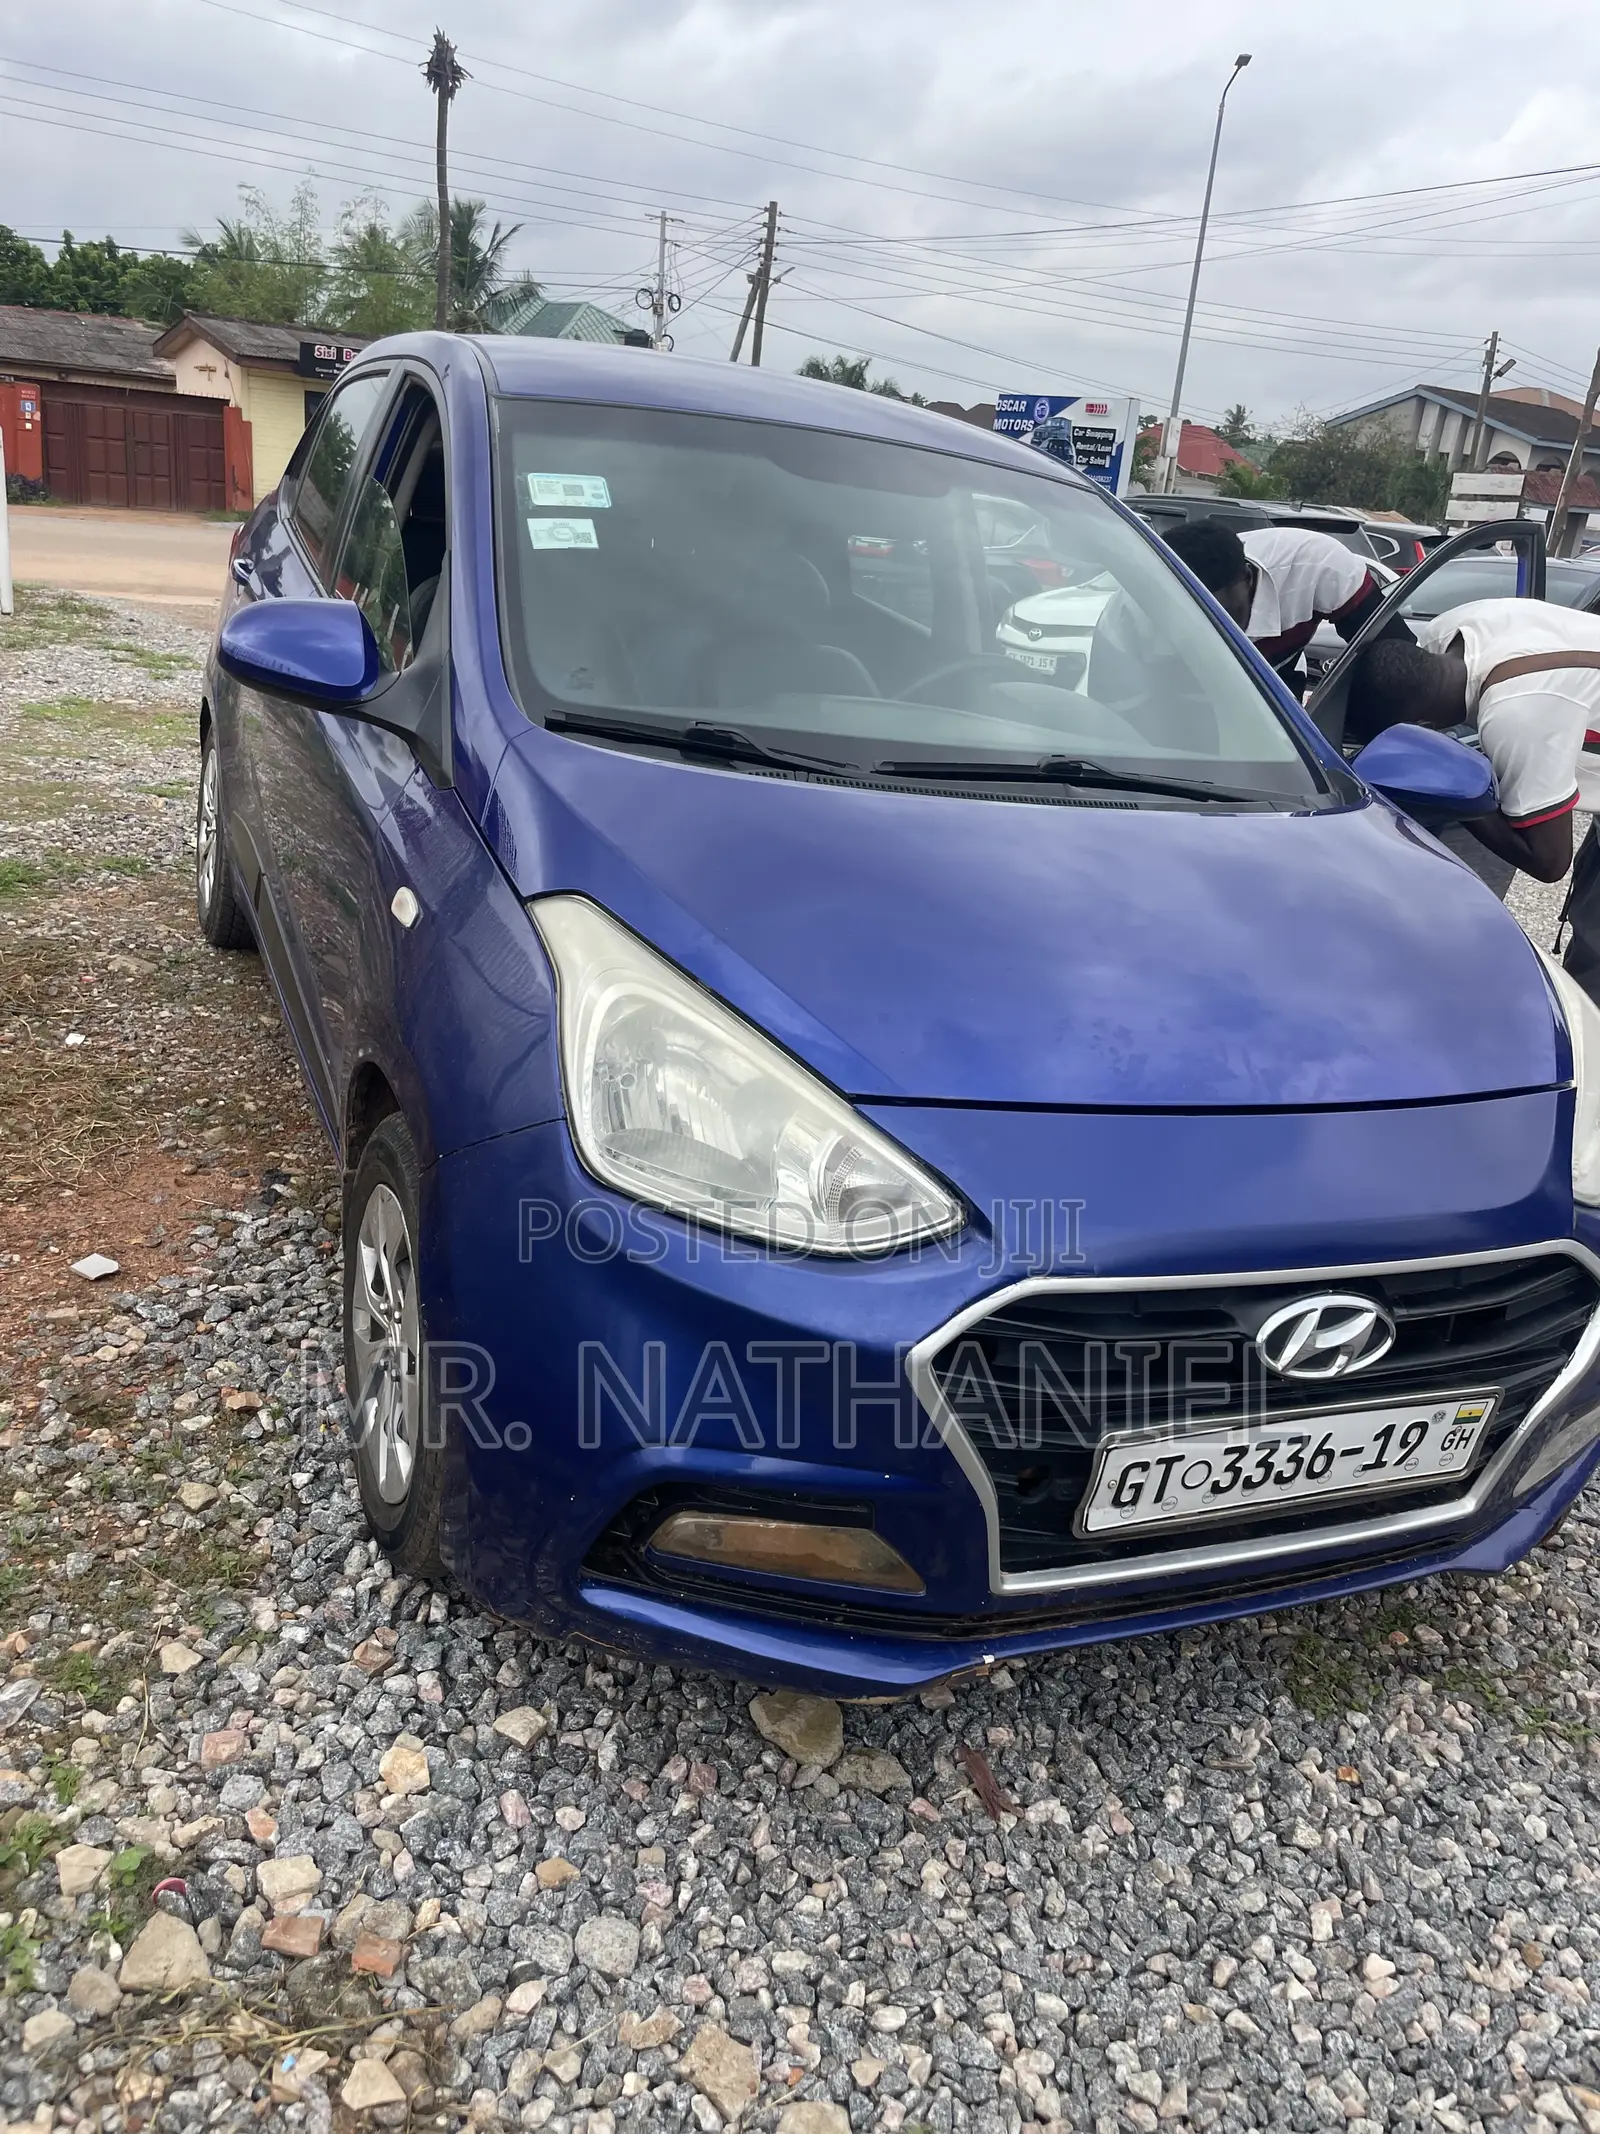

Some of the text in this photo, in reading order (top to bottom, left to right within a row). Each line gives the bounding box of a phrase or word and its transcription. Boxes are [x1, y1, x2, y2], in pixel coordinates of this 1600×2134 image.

[314, 345, 337, 359] Sisi
[995, 399, 1027, 412] OSCAR
[993, 418, 1034, 432] MOTORS
[1073, 428, 1114, 440] Car Swapping
[1077, 455, 1106, 466] Car Sales
[1440, 1427, 1475, 1452] GH
